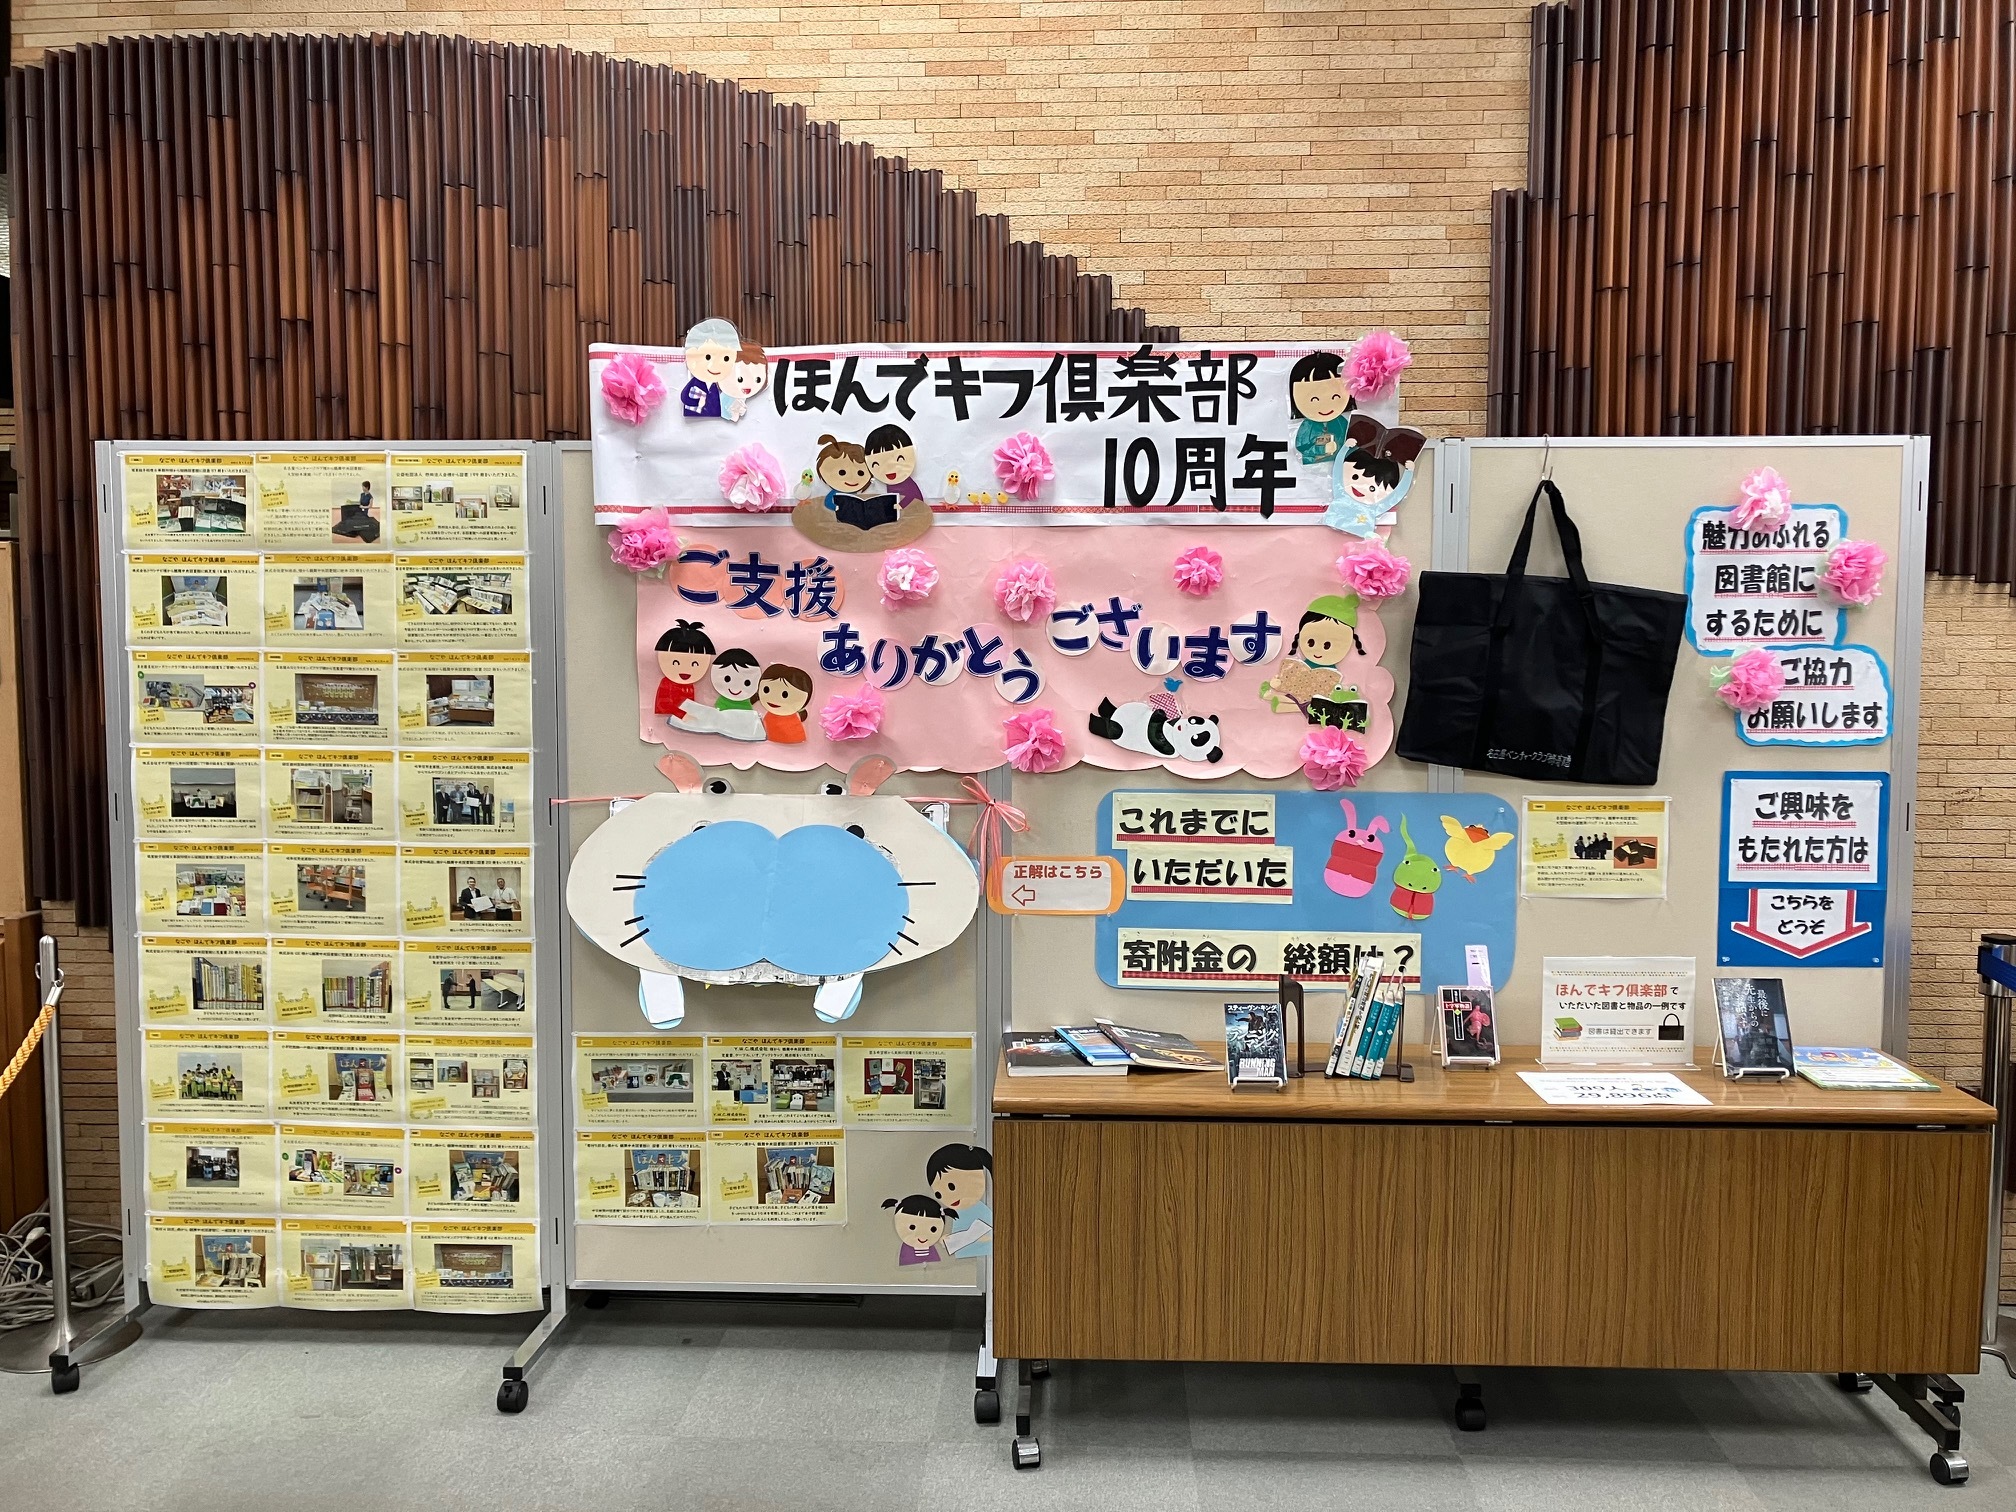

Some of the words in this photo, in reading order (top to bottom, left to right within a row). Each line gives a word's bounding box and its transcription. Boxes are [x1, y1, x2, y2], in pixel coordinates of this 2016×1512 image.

[774, 344, 1257, 426] ほんでキフ倶楽部
[1104, 434, 1298, 517] 10周年
[1702, 520, 1830, 550] 魅力あふれる
[677, 547, 841, 619] ご支援
[1715, 563, 1816, 594] 図書館に
[1706, 609, 1823, 637] するために
[820, 622, 1043, 704] ありがとう
[1047, 596, 1283, 683] ございます
[1780, 656, 1852, 686] ご協力
[1747, 701, 1882, 729] お願いします
[1755, 791, 1854, 821] ご興味を
[1118, 806, 1270, 837] これまでに
[1738, 835, 1869, 863] もたれた方は
[1013, 863, 1103, 881] 正解はこちら
[1133, 856, 1288, 887] いただいた
[1770, 895, 1834, 910] こちらを
[1122, 940, 1256, 973] 寄附金の
[1559, 1002, 1687, 1011] いただいた図書と物品の一例です
[1588, 1028, 1651, 1036] 図書は貸出できます
[1239, 1058, 1276, 1068] RUNNING
[1256, 1067, 1275, 1077] MAN
